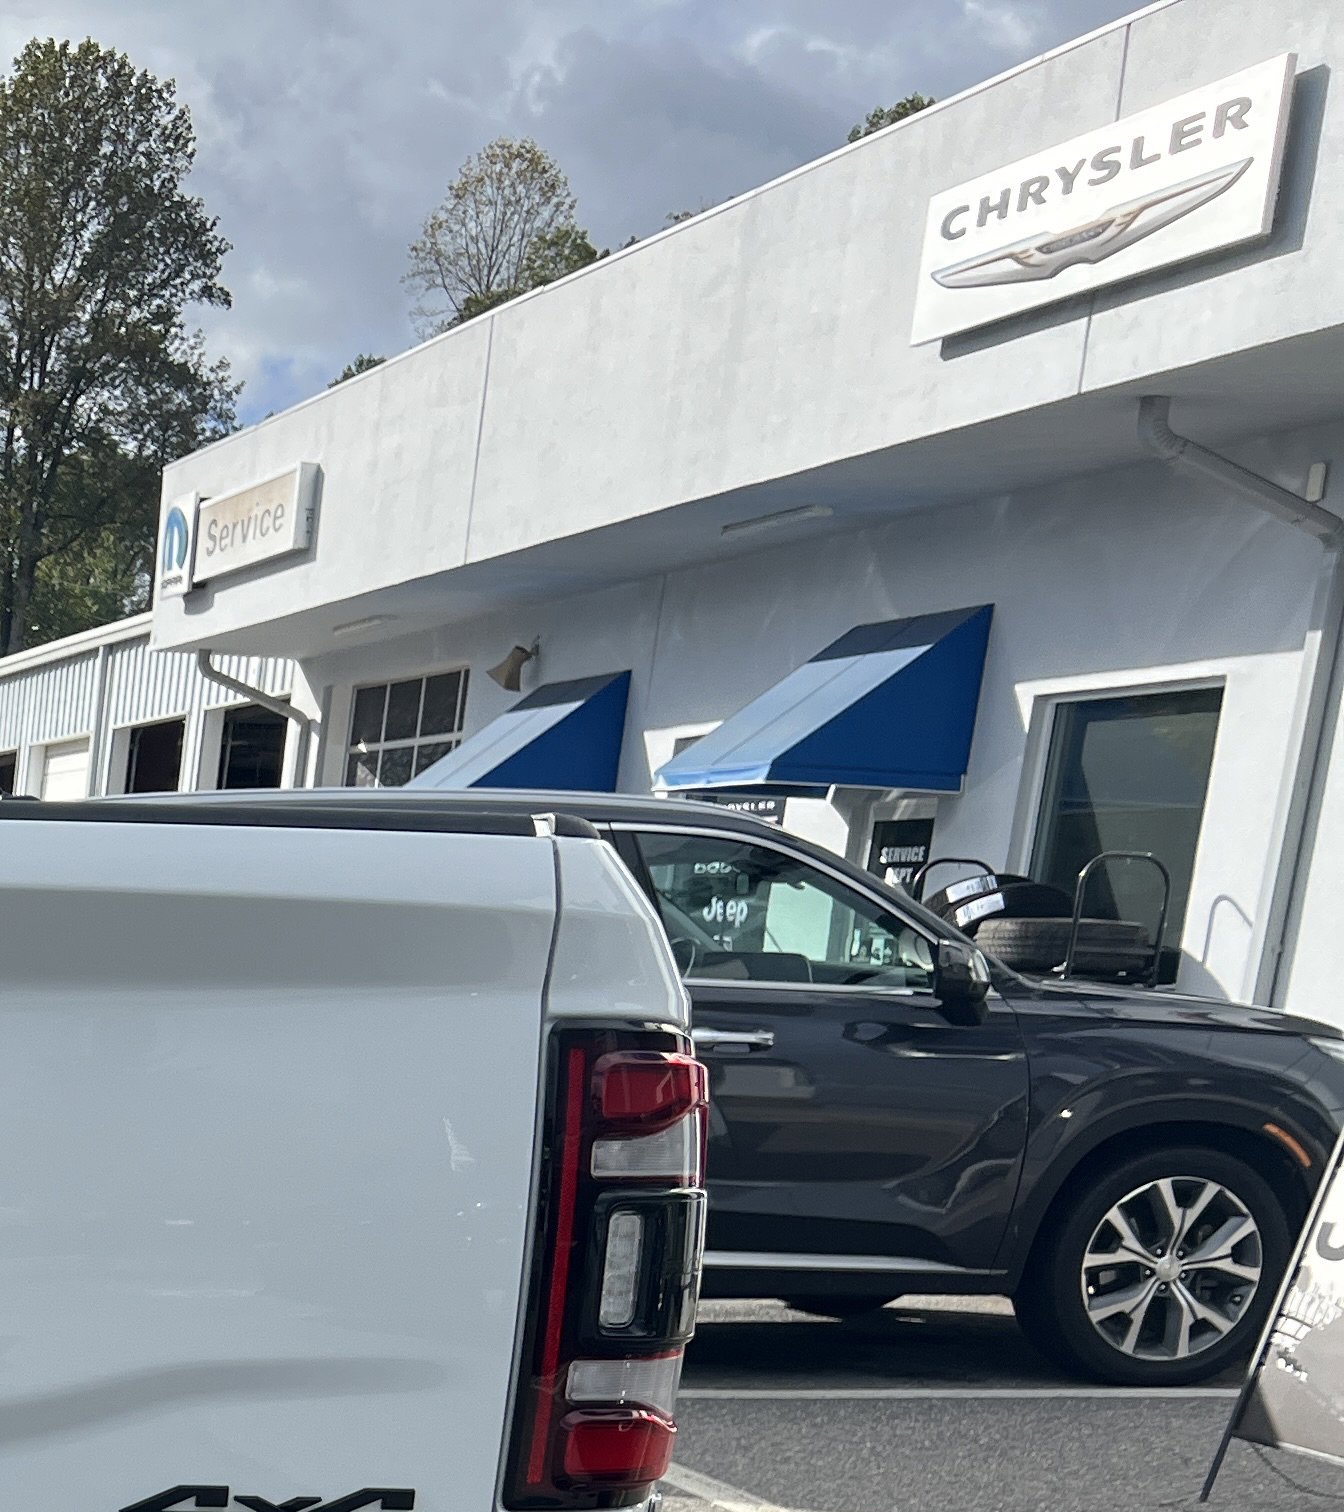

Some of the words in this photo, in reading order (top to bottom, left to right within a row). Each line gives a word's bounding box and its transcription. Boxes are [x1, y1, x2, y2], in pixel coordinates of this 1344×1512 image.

[941, 97, 1252, 240] CHRYSLER
[206, 502, 286, 557] Service
[880, 845, 926, 864] SERVICE
[702, 896, 749, 929] Jeep
